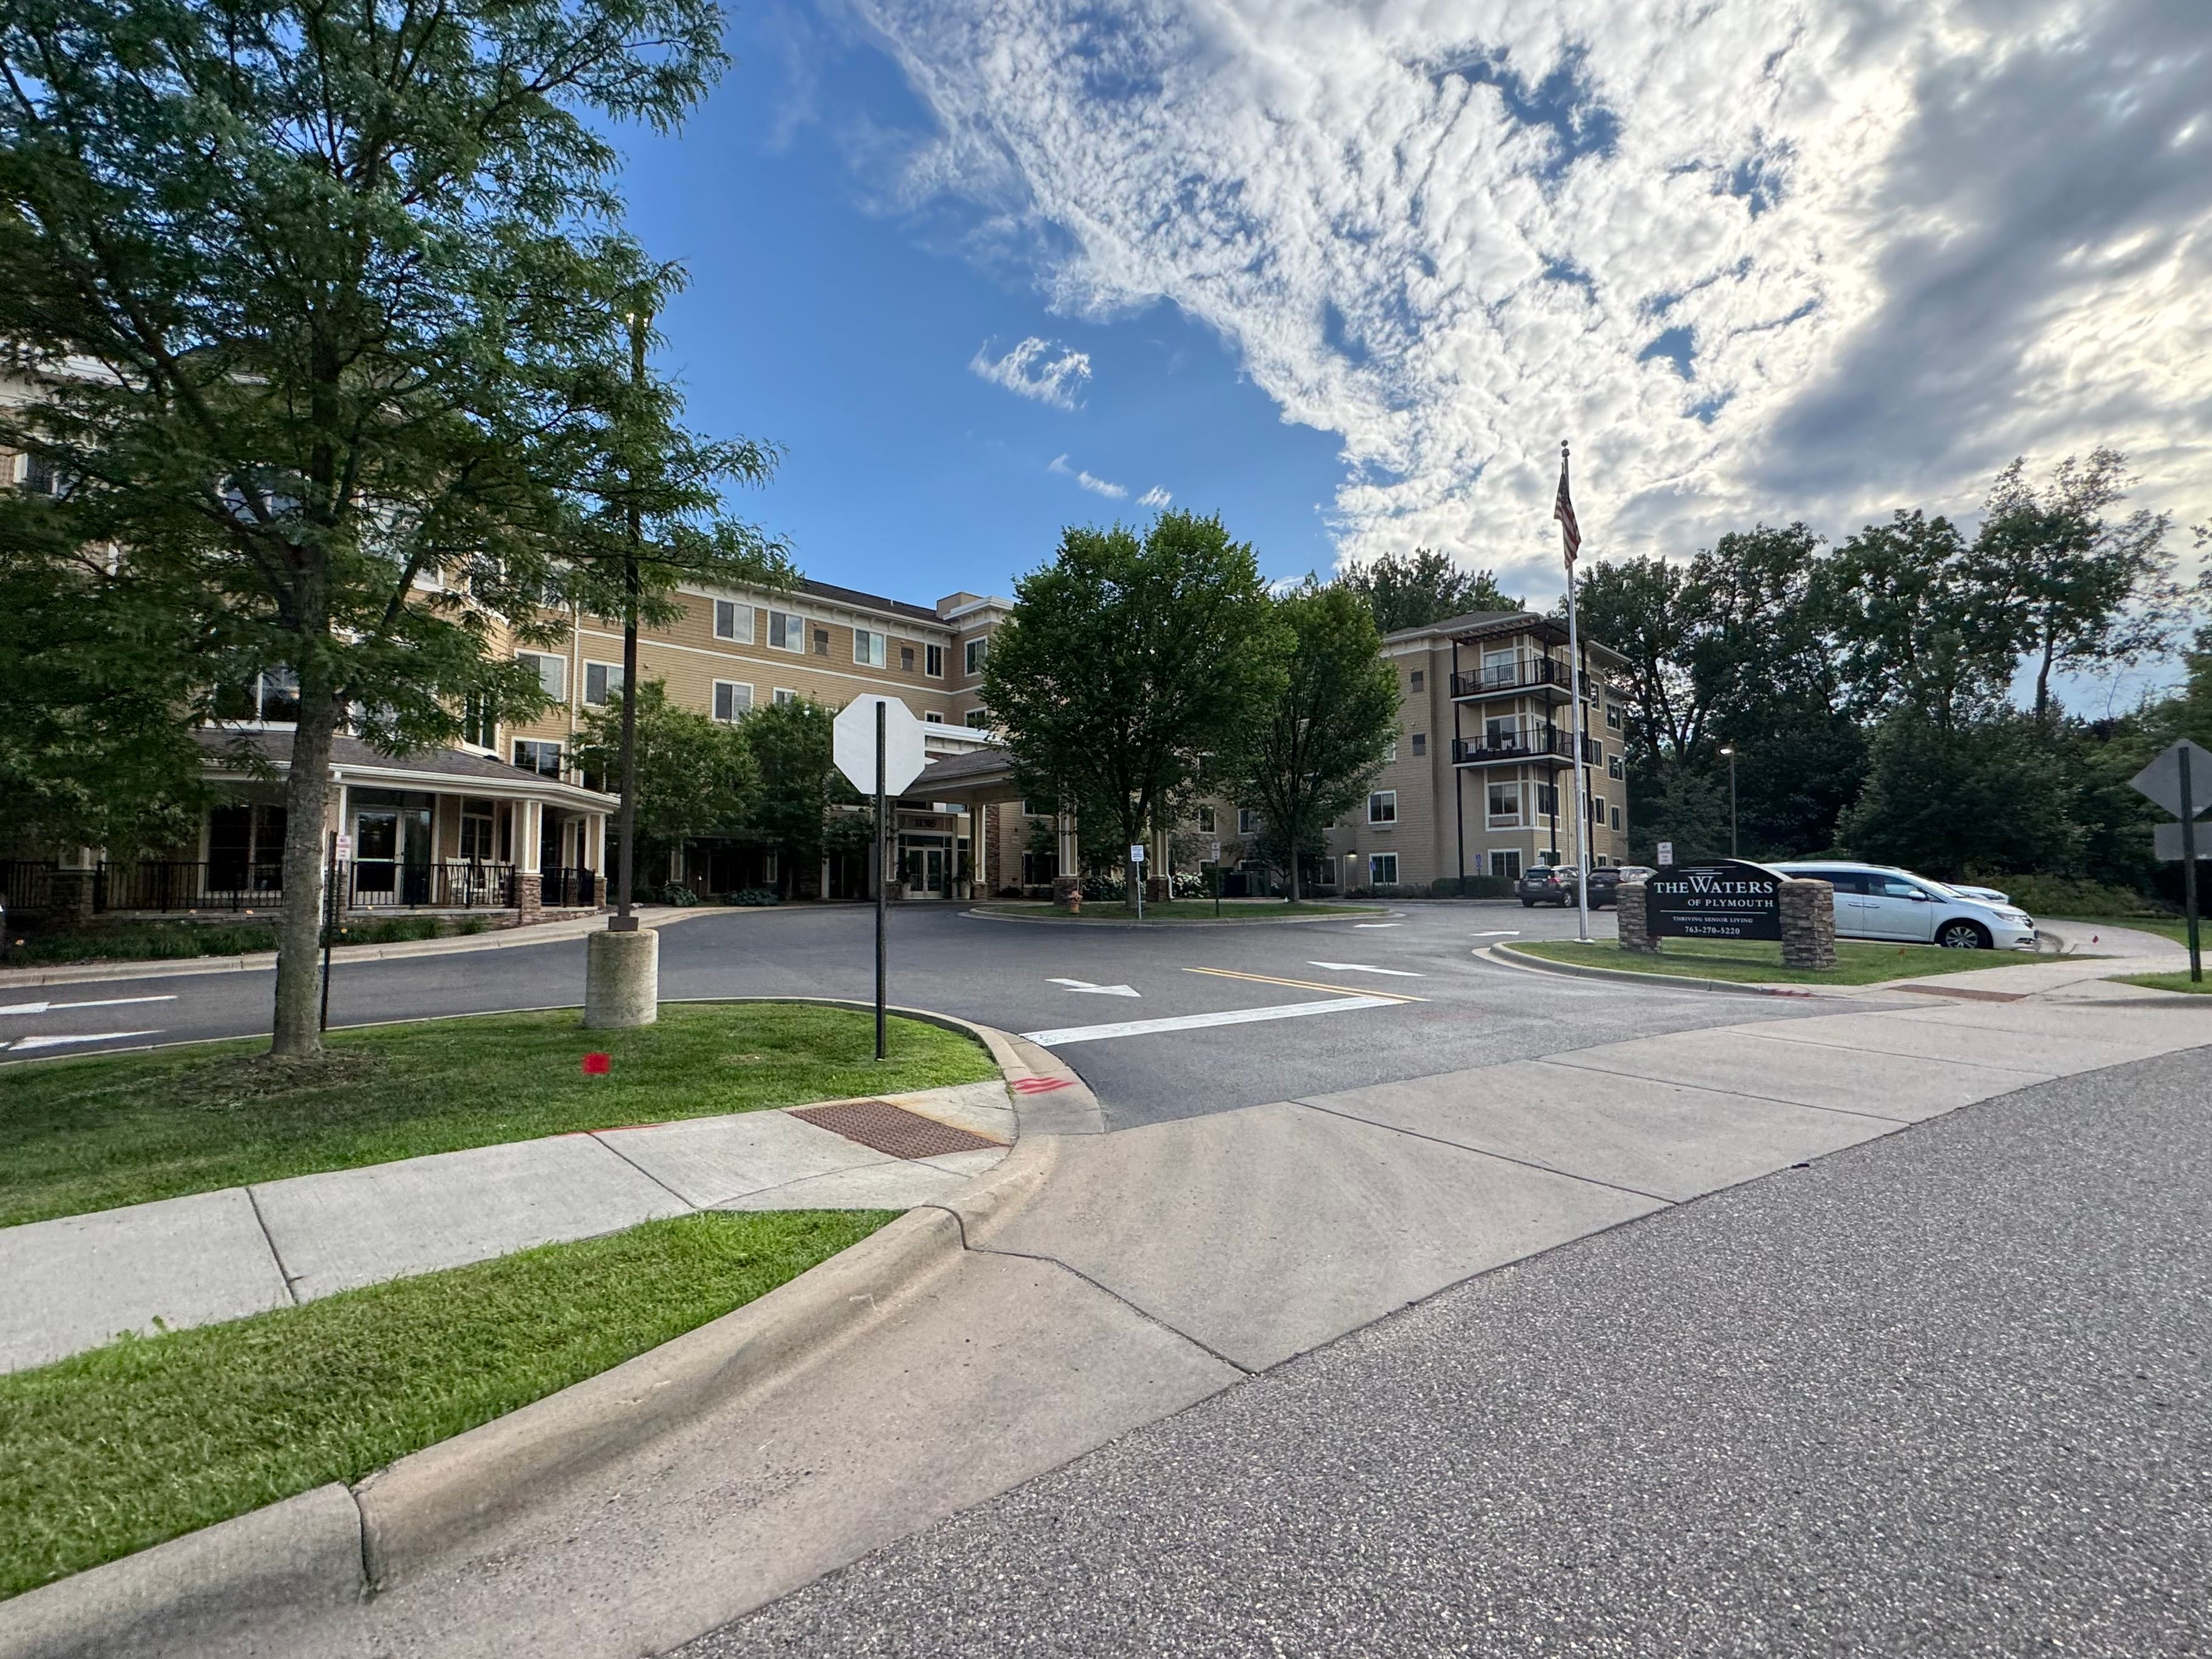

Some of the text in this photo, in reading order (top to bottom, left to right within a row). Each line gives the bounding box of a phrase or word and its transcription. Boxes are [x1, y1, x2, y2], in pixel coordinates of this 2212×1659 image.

[1654, 876, 1773, 893] THE WATERS
[1705, 899, 1774, 907] PLYMOUTH
[1685, 926, 1740, 935] 763-270-5220
